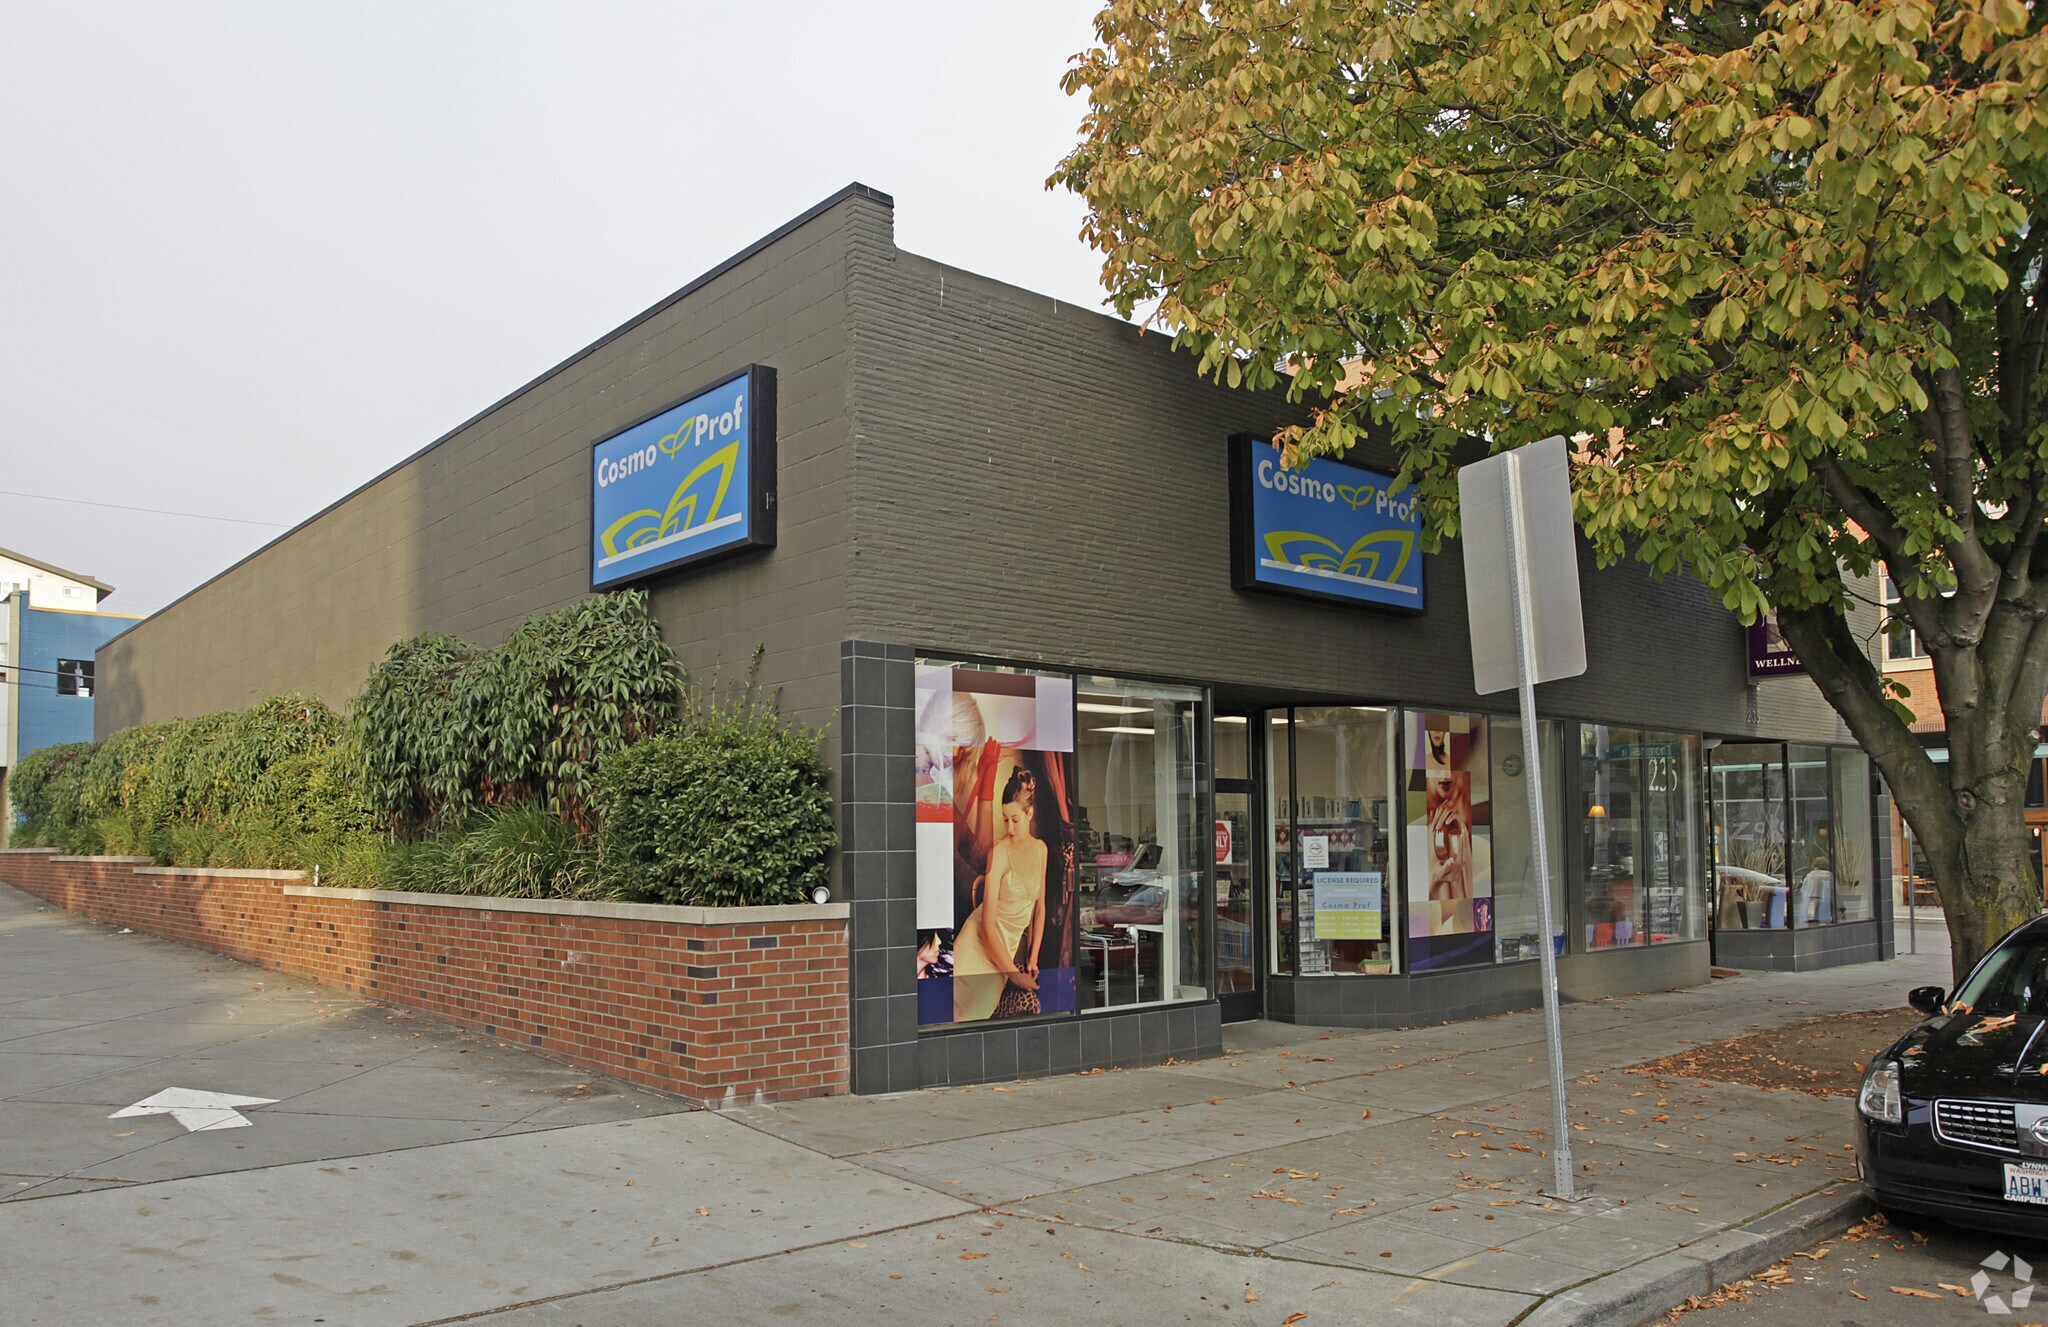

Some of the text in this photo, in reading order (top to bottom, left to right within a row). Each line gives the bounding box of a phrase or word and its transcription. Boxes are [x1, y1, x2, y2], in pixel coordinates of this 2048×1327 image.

[597, 395, 743, 488] Cosmo Prof
[1258, 459, 1418, 523] Cosmo Prof
[2009, 1167, 2048, 1176] WASHINGT
[2010, 1175, 2048, 1196] ABW
[2003, 1193, 2048, 1205] CAMPBEL
